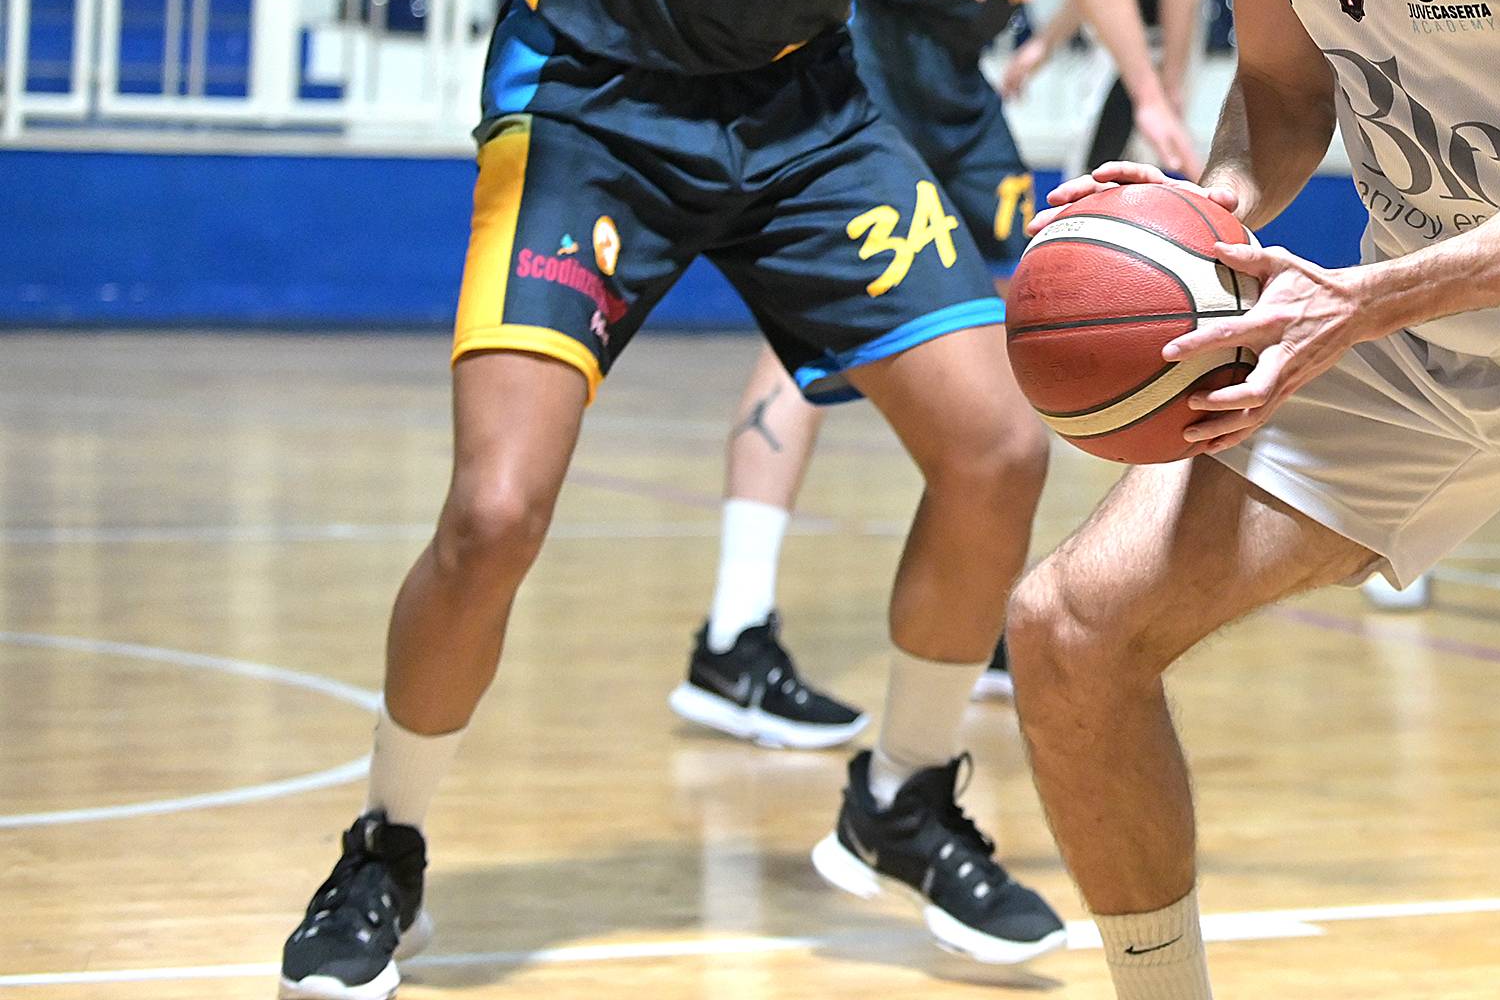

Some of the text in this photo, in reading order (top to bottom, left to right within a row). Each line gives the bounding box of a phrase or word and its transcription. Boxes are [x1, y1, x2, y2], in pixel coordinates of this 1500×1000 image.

[1407, 2, 1492, 20] JUVECASERTA
[1412, 18, 1495, 34] ACADEMY
[846, 180, 958, 297] 34
